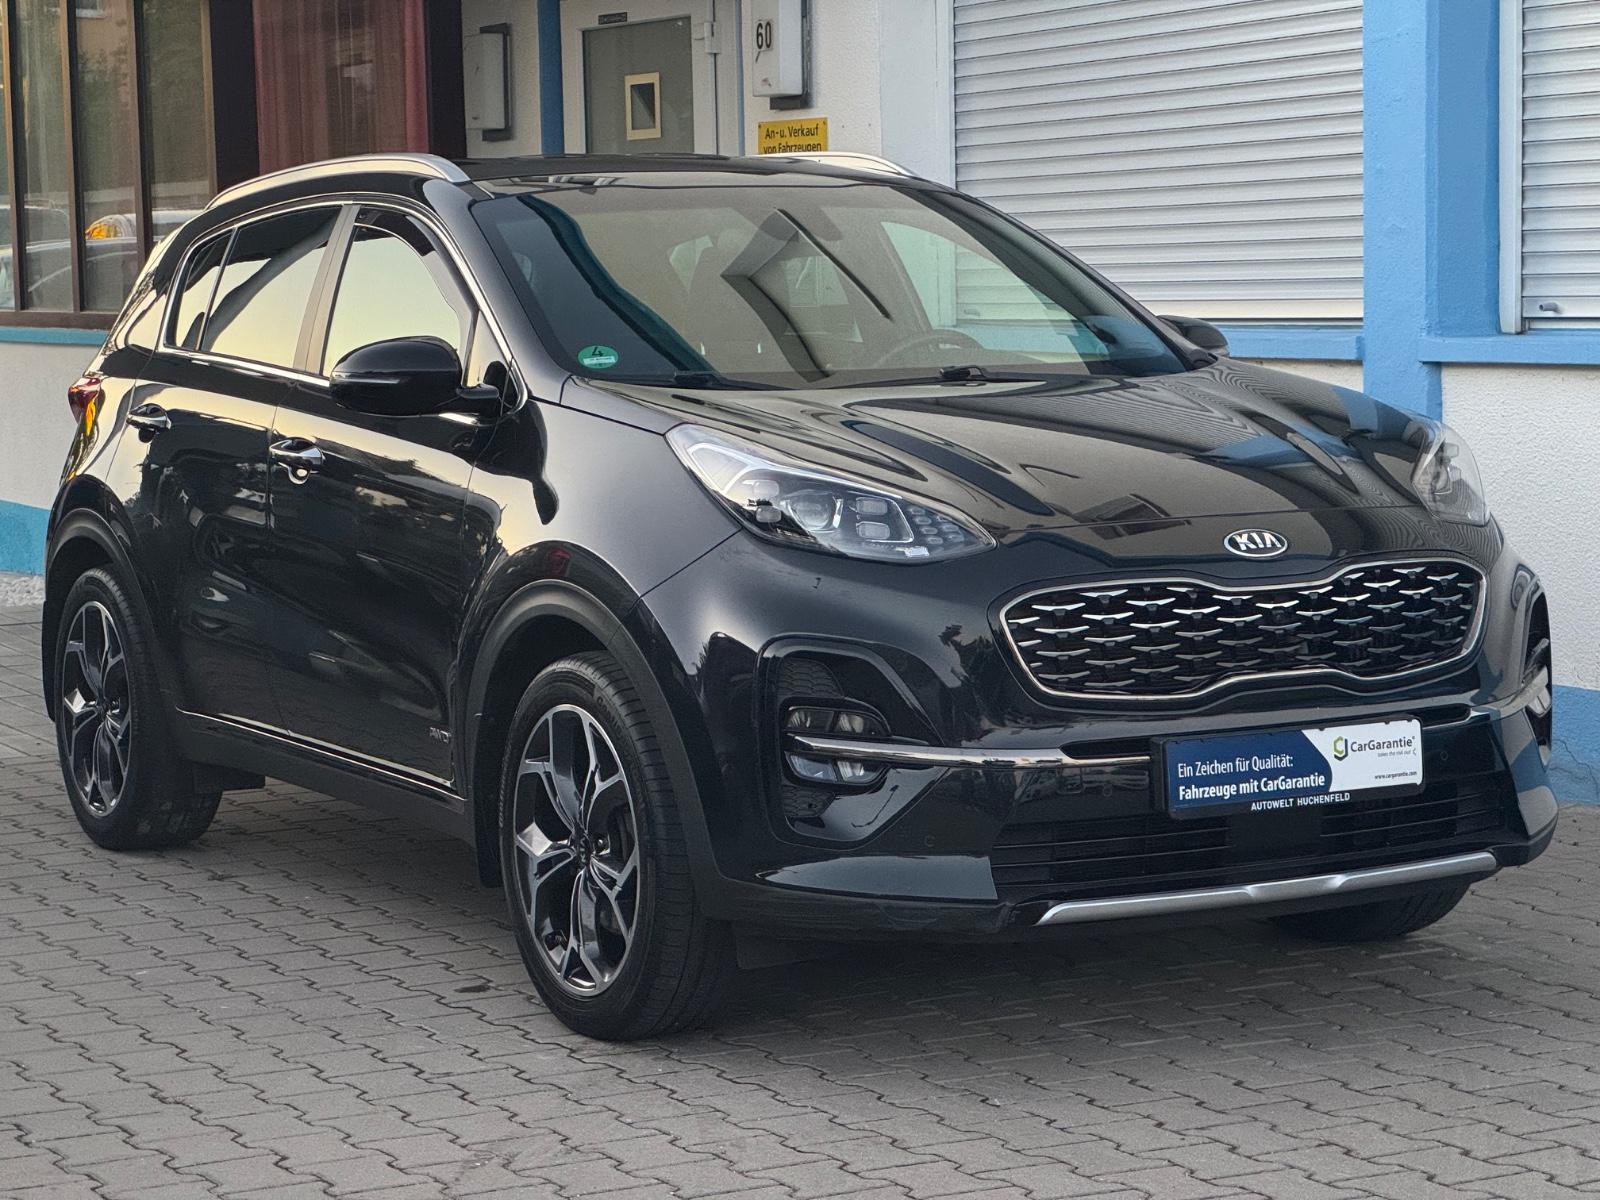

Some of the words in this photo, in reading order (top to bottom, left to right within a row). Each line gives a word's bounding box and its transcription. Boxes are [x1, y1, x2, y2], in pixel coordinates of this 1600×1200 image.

[756, 21, 772, 50] 60
[788, 123, 819, 137] Verkauf
[763, 144, 777, 154] von
[591, 346, 604, 357] 4
[1232, 532, 1282, 551] KIA
[1350, 736, 1413, 752] CarGarantie
[1178, 763, 1193, 778] Ein
[1195, 759, 1234, 777] Zeichen
[1235, 757, 1250, 772] für
[1251, 754, 1294, 771] Qualität:
[1179, 781, 1237, 800] Fahrzeuge
[1239, 779, 1259, 794] mit
[1260, 772, 1326, 793] CarGarantie
[1251, 798, 1294, 811] AUTOWELT
[1297, 792, 1350, 807] HUCHENFELD
